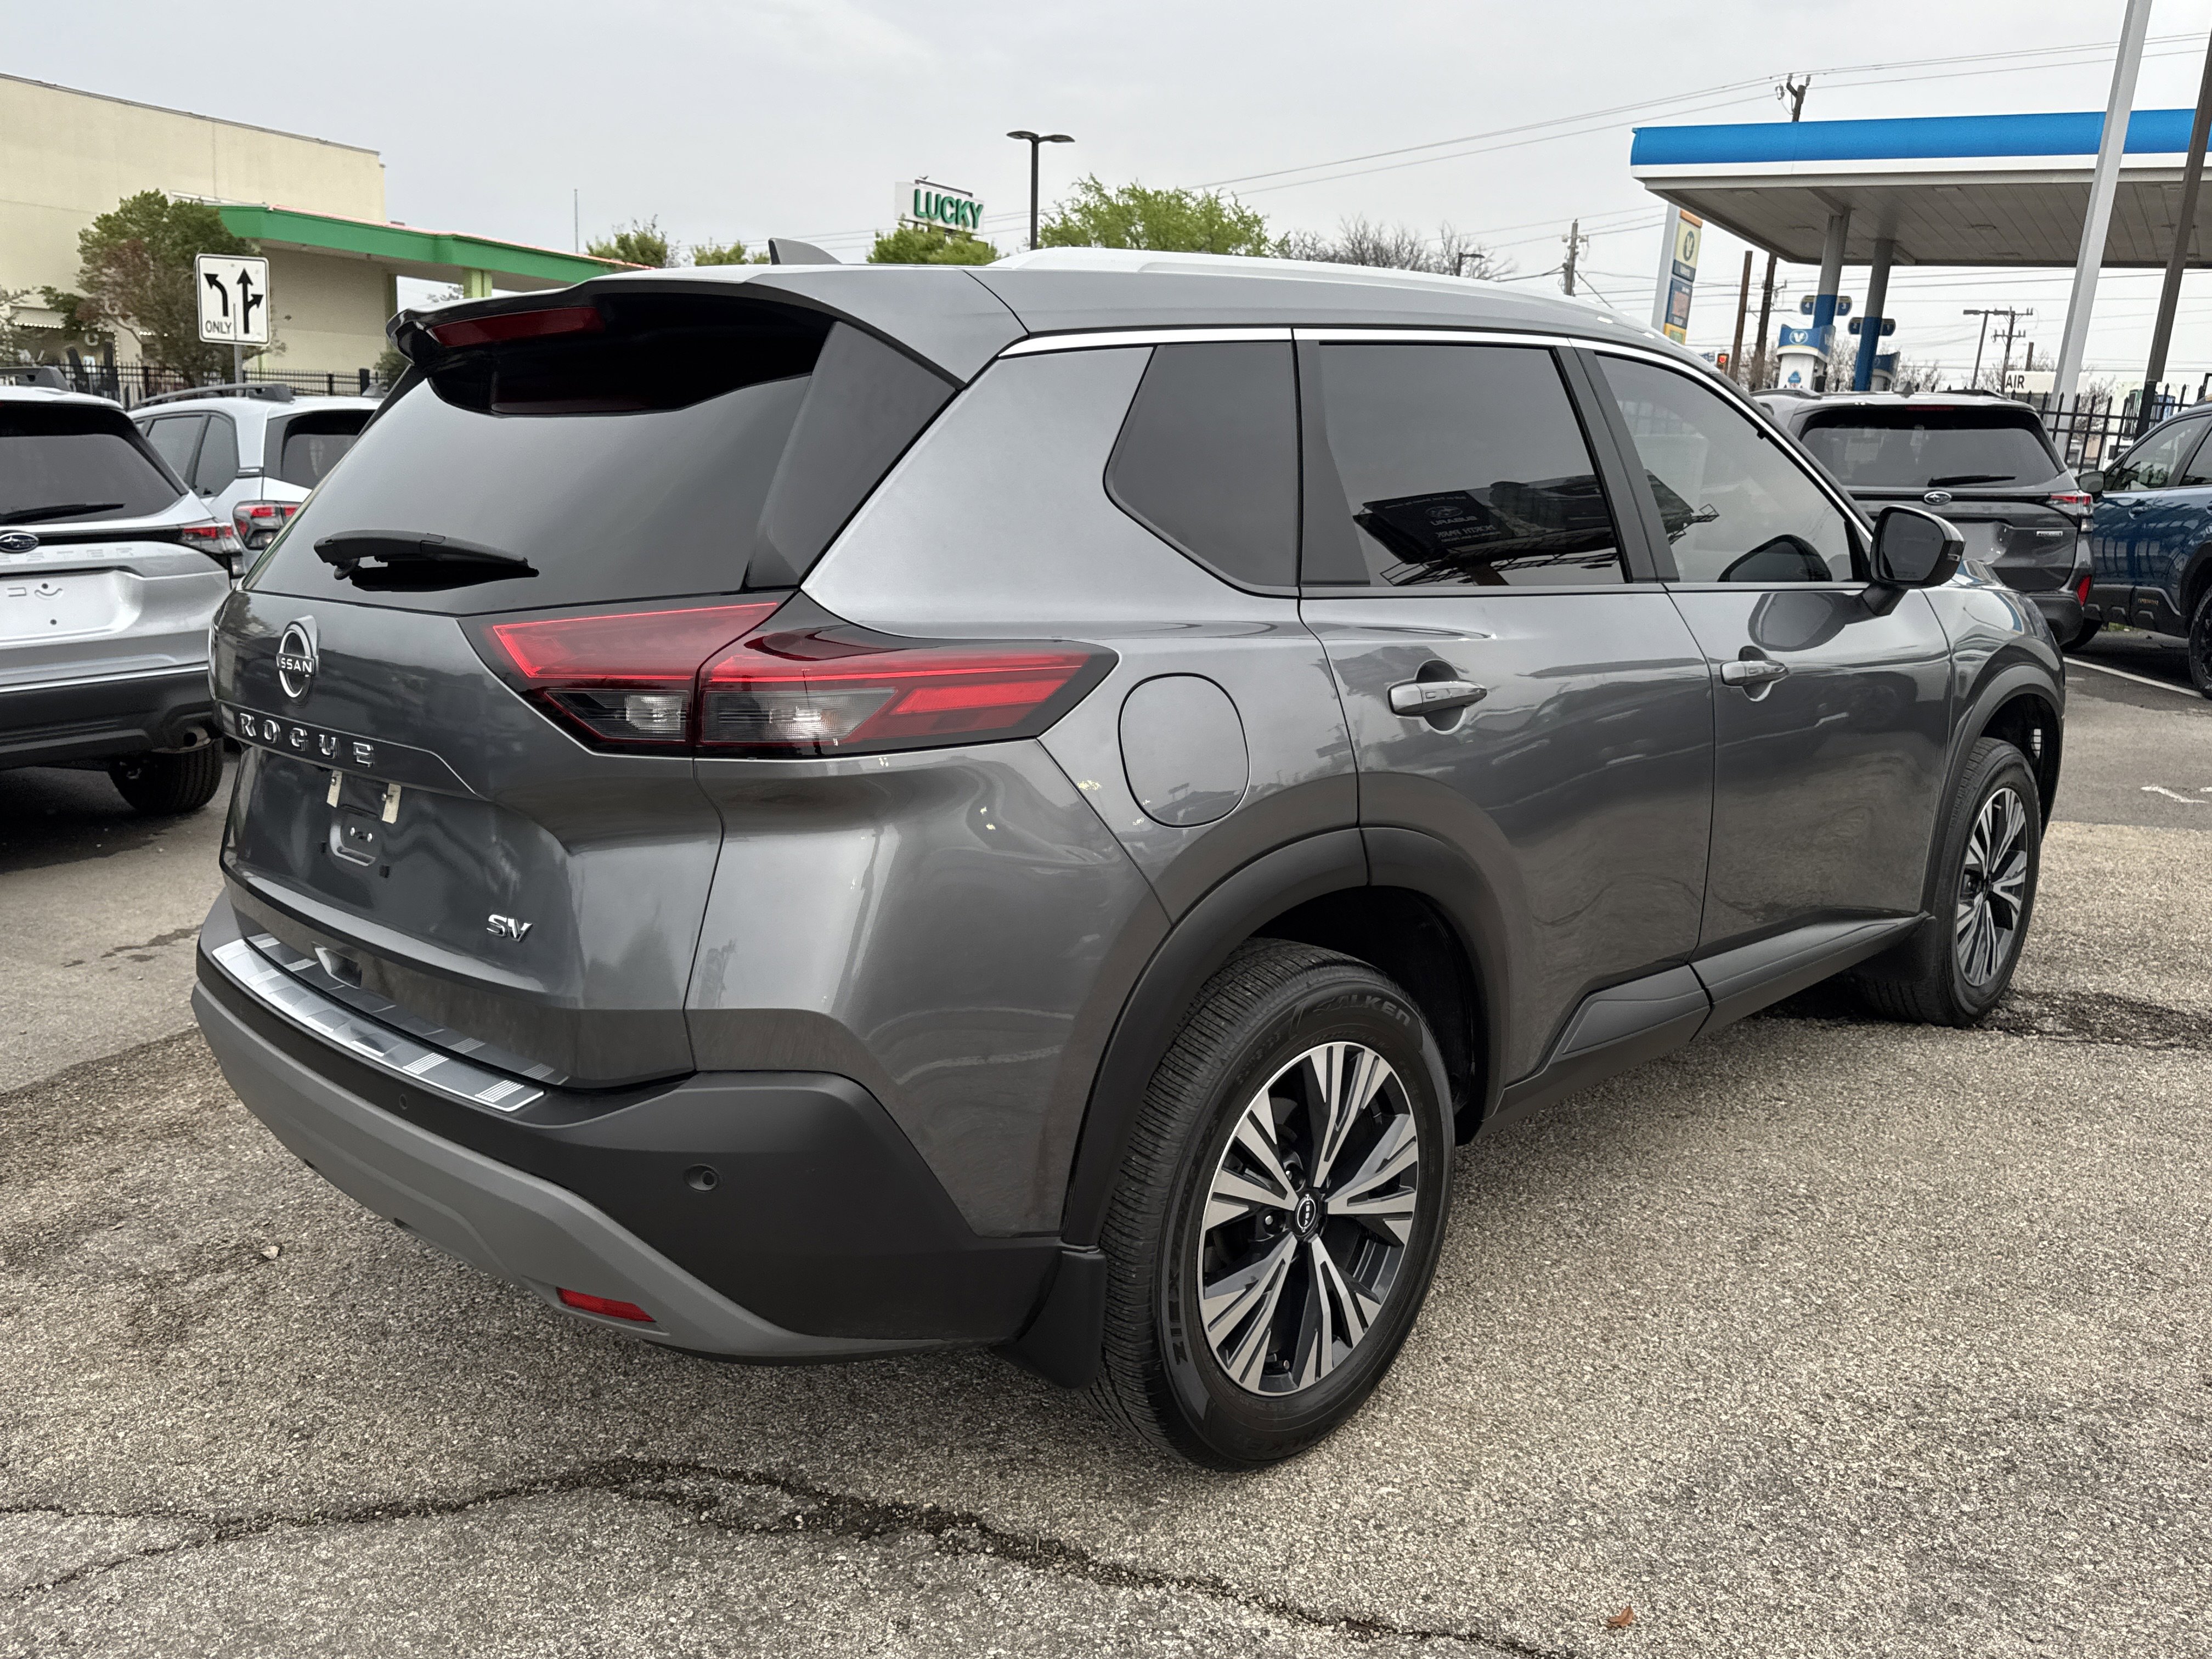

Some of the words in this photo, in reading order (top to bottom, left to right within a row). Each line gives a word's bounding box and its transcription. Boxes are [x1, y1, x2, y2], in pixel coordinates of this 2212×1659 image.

[914, 189, 984, 229] LUCKY
[1841, 302, 1847, 310] 3
[205, 320, 232, 334] ONLY
[2005, 374, 2025, 389] AIR
[240, 713, 374, 768] ROGUE
[486, 914, 533, 943] SV
[1313, 994, 1410, 1026] FALKEN
